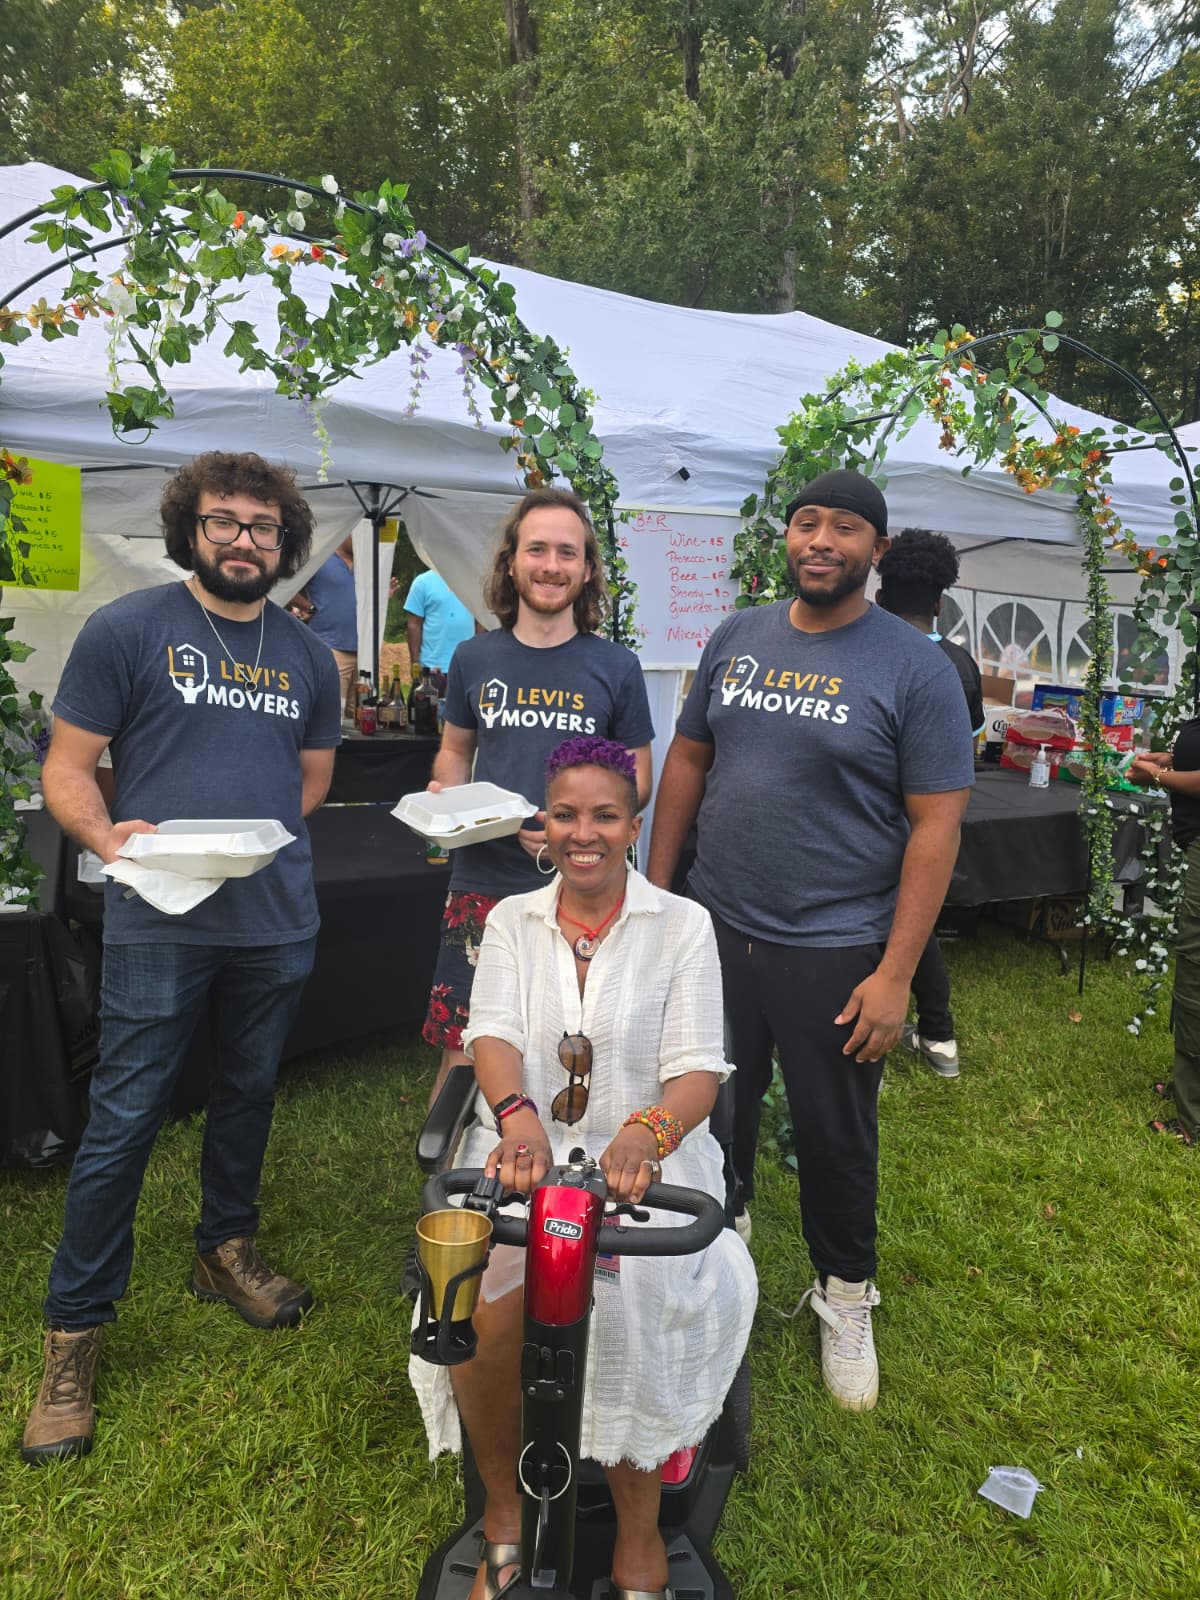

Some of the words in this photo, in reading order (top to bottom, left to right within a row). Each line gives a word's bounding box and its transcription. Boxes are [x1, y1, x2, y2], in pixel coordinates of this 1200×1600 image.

[636, 513, 668, 528] BAR
[670, 532, 700, 547] Wine
[220, 660, 290, 691] LEVI'S
[763, 669, 843, 695] LEVI'S
[206, 684, 300, 720] MOVERS
[517, 687, 584, 710] LEVI'S
[740, 689, 850, 724] MOVERS
[501, 709, 596, 735] MOVERS
[548, 1221, 578, 1236] Pride
